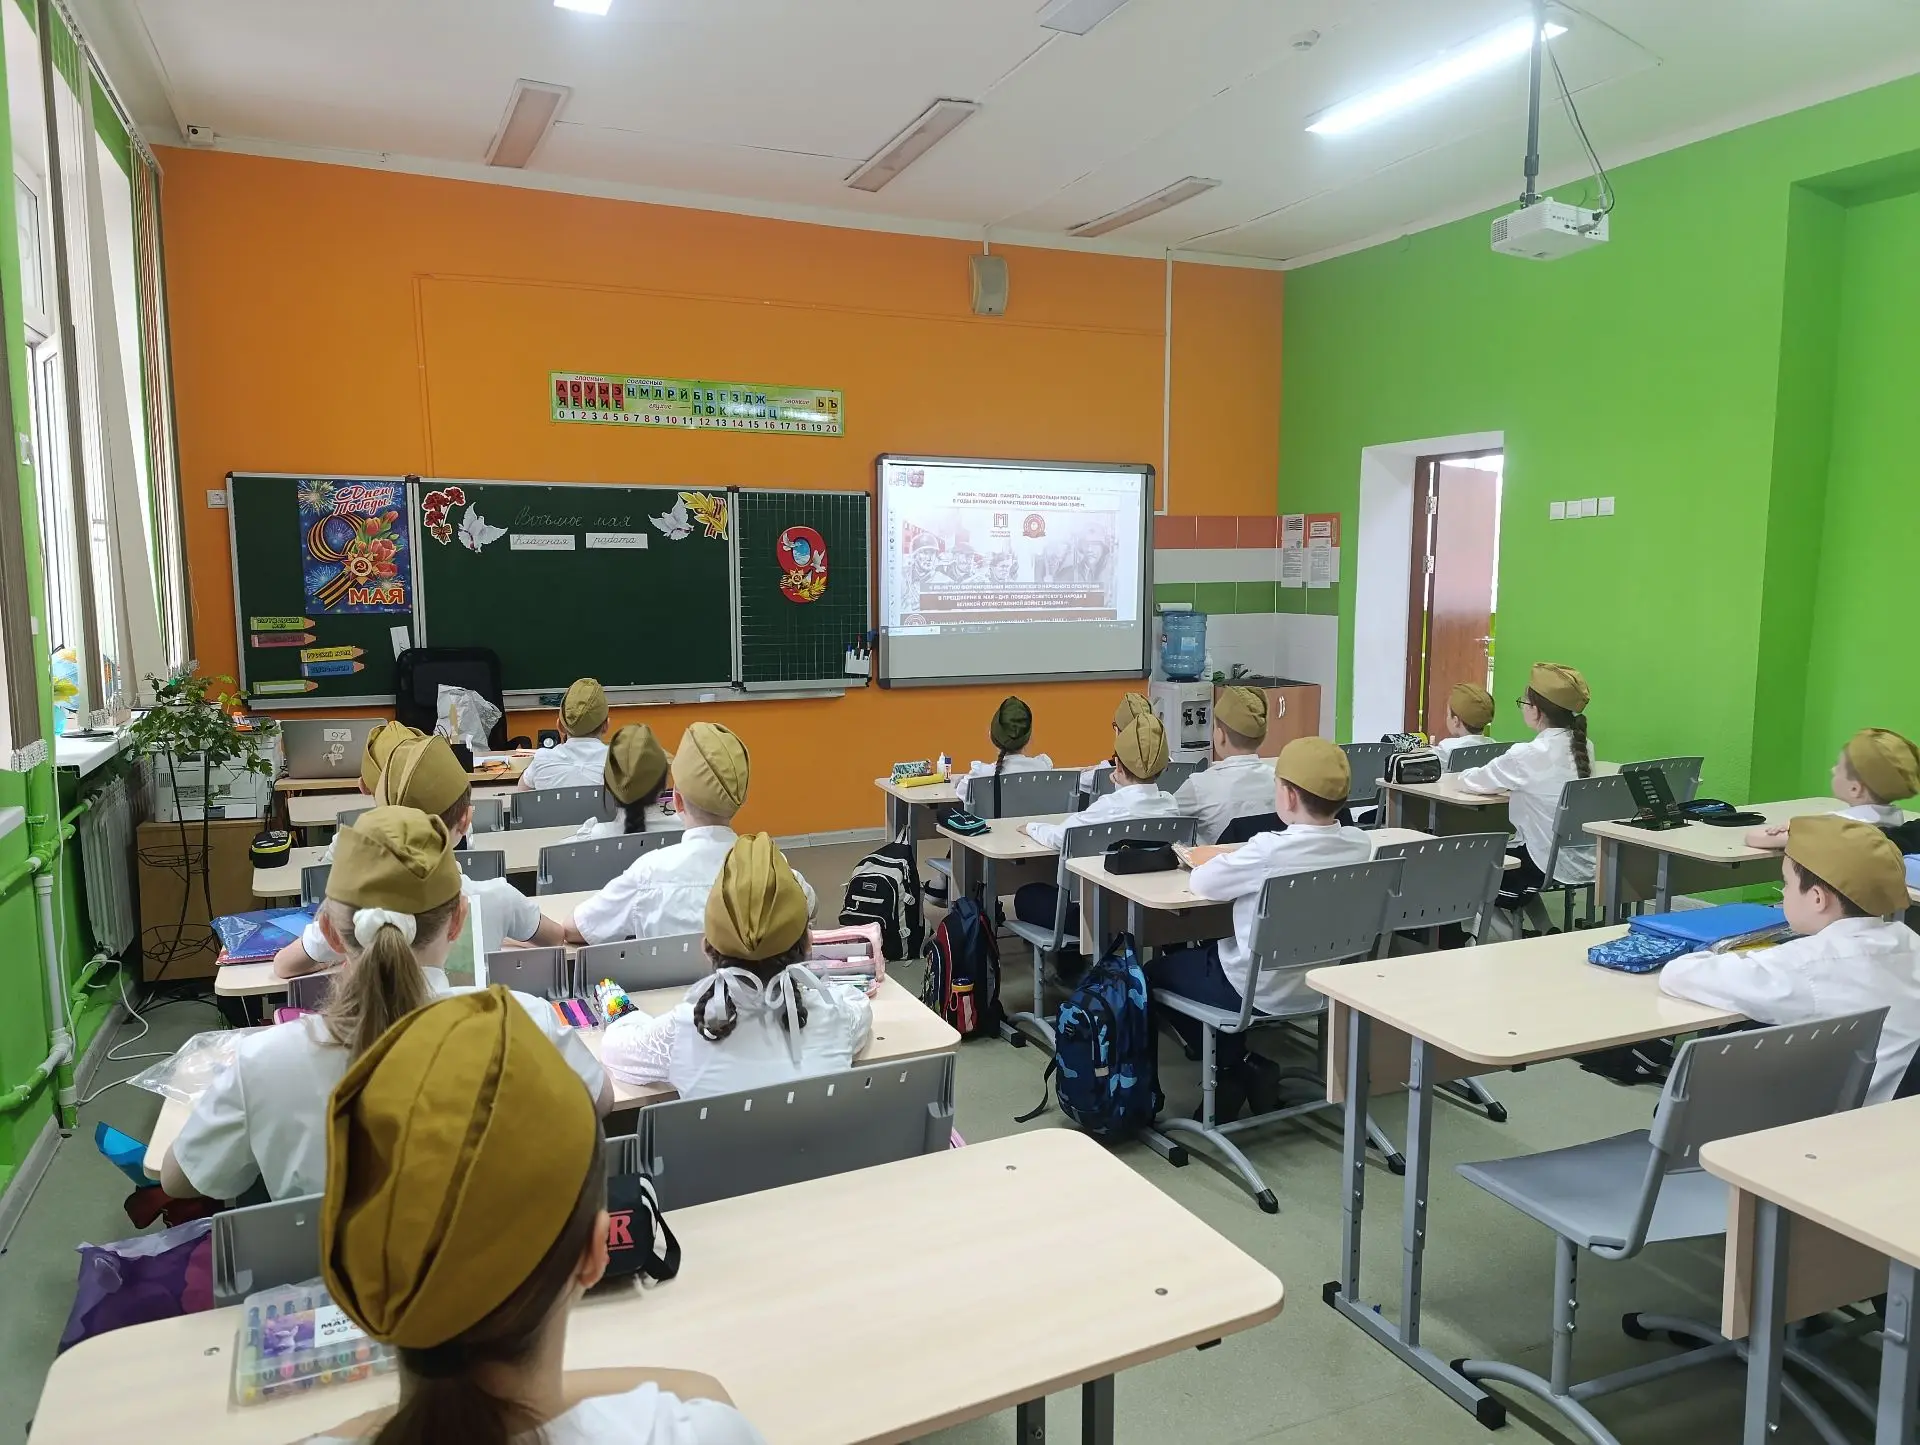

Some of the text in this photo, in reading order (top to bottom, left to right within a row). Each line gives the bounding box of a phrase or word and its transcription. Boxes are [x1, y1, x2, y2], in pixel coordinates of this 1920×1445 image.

[626, 378, 663, 386] согласные
[627, 387, 766, 405] Н М Л Р Й Б В Г З Д Ж
[818, 399, 838, 409] Ь Ъ
[666, 416, 677, 424] 10
[683, 416, 693, 425] 11
[700, 417, 710, 426] 12
[716, 418, 727, 427] 13
[732, 419, 743, 428] 14
[748, 420, 759, 429] 15
[765, 421, 775, 429] 16
[781, 422, 791, 430] 17
[796, 423, 807, 431] 18
[811, 423, 822, 432] 19
[826, 424, 837, 433] 20
[335, 485, 390, 501] С Днем
[514, 505, 631, 527] Восьмое мая
[349, 588, 404, 604] МАЯ
